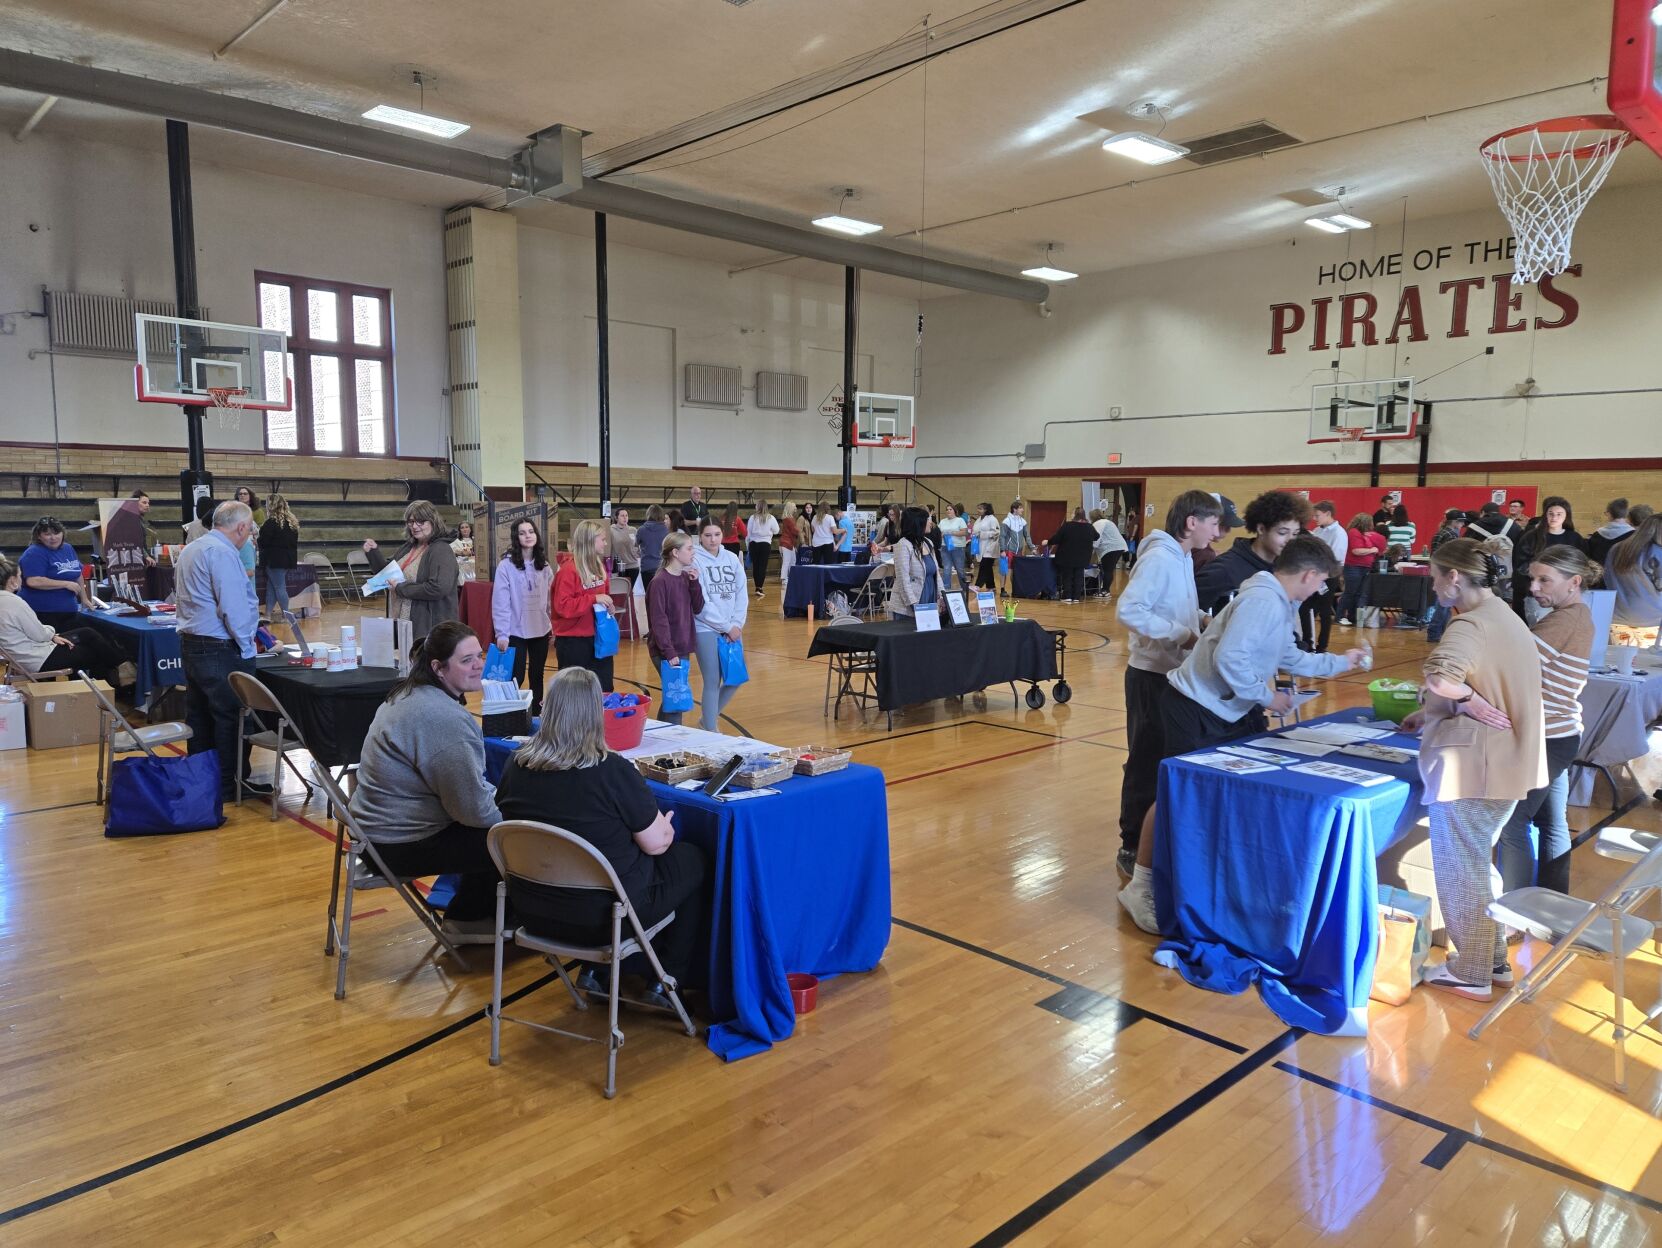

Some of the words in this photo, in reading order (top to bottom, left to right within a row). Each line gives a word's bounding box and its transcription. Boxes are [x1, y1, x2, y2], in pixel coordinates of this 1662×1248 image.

[1317, 252, 1403, 285] HOME
[1413, 246, 1452, 271] OF
[1464, 236, 1518, 265] THE
[1267, 263, 1583, 355] PIRATES
[498, 511, 524, 523] BOARD
[525, 507, 537, 516] KIT
[708, 582, 737, 593] FINAL
[157, 657, 182, 670] CHI
